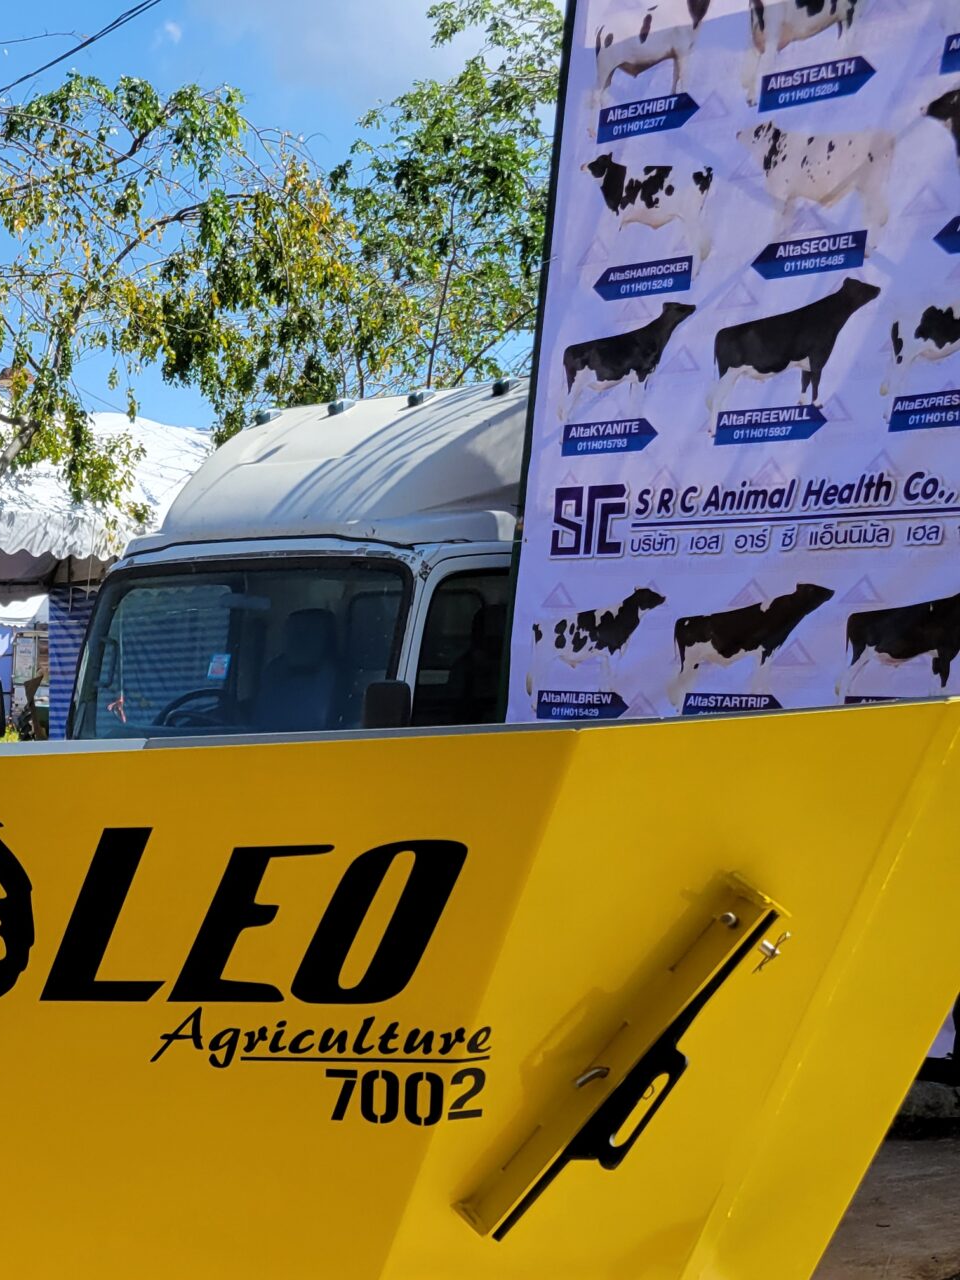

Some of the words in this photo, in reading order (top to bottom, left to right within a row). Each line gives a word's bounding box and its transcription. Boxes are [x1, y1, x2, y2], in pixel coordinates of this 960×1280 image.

[768, 59, 856, 91] AltaSTEALTH
[606, 97, 678, 123] AltaEXHIBIT
[612, 116, 667, 136] 011H012377
[775, 235, 857, 258] AltaSEQUEL
[608, 262, 689, 282] AltaSHAMROCKER
[783, 254, 845, 272] 011H015485
[620, 278, 674, 294] 011H015249
[719, 408, 811, 427] AltaFREEWILL
[569, 421, 640, 438] AltaKYANITE
[733, 426, 793, 440] 011H015937
[577, 438, 628, 451] 011H015793
[635, 488, 651, 515] S
[657, 487, 674, 515] R
[680, 486, 698, 513] C
[702, 478, 797, 512] Animal
[802, 471, 892, 507] Health
[903, 471, 955, 504] Co.,
[630, 532, 676, 552] บริษัท
[690, 533, 721, 550] เอส
[734, 528, 768, 549] อาร์
[781, 526, 796, 547] ซี
[906, 524, 940, 542] เฮล
[541, 692, 612, 704] AltaMILBREW
[686, 695, 770, 708] AltaSTARTRIP
[551, 707, 600, 717] 011H015429
[40, 827, 469, 1004] LEO
[150, 1006, 492, 1068] Agriculture
[325, 1067, 487, 1127] 7002
